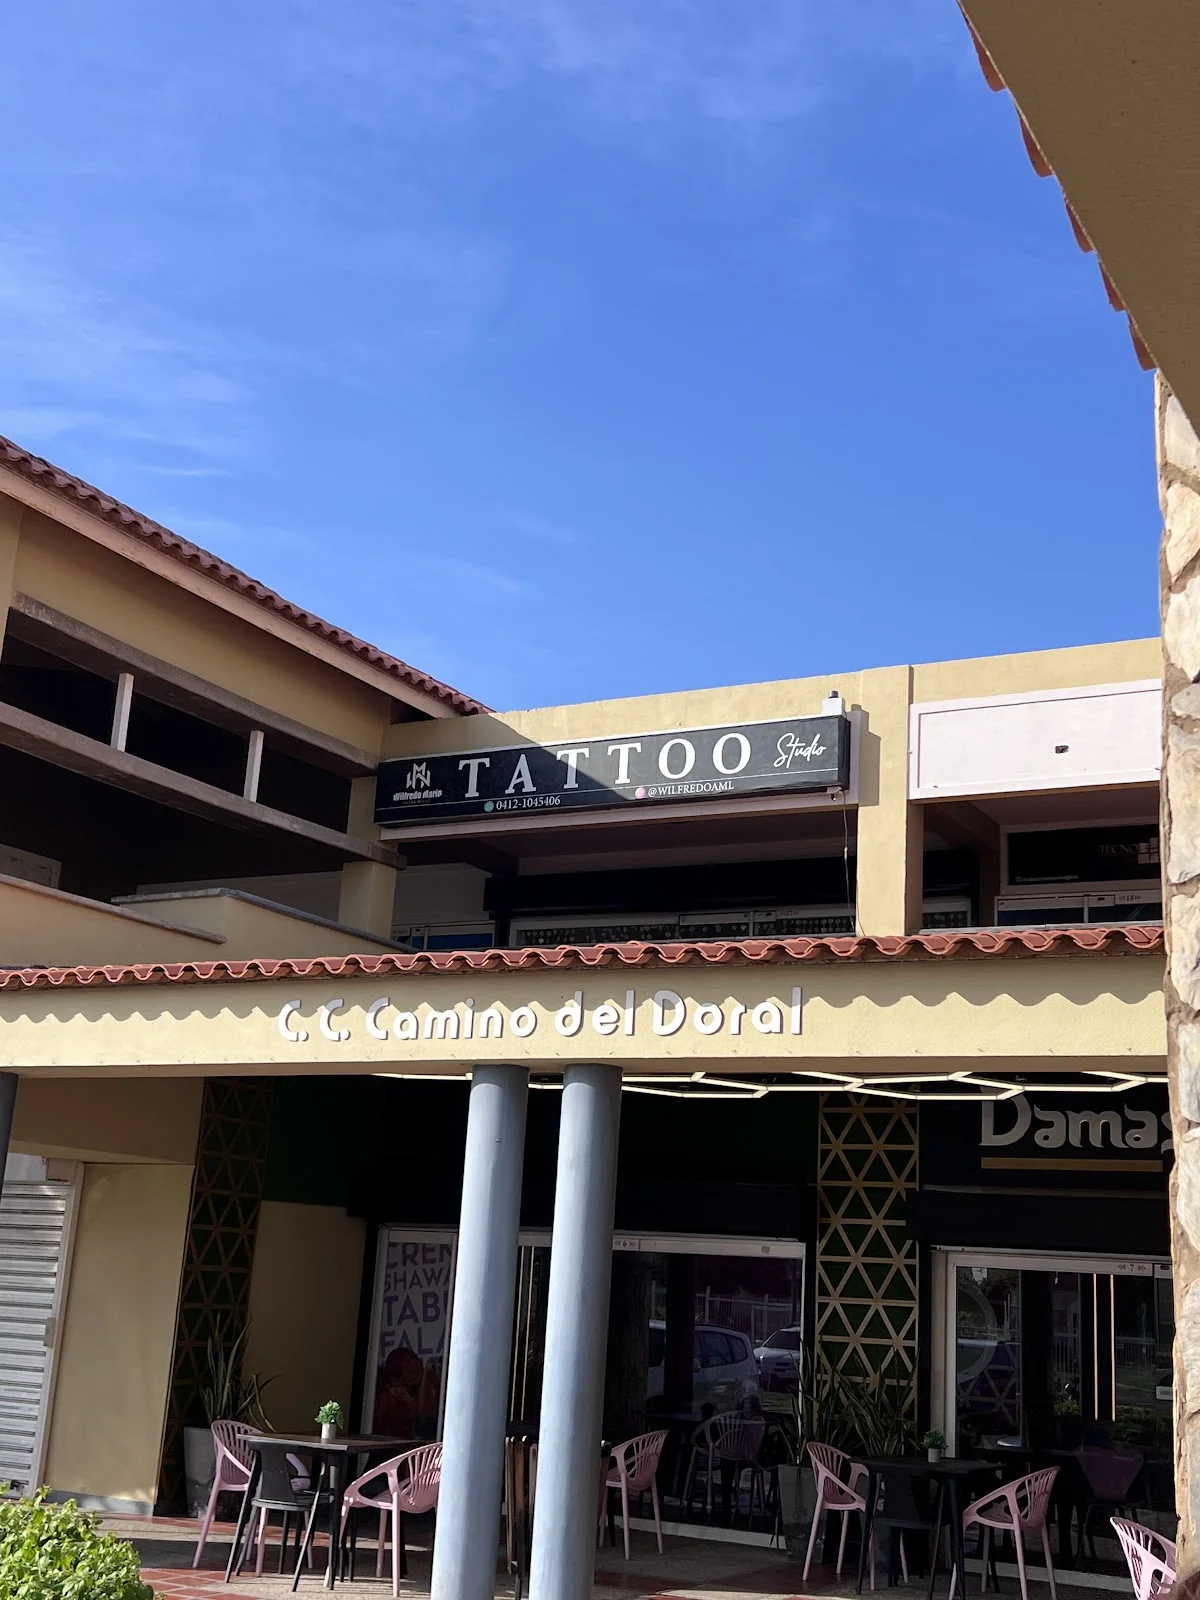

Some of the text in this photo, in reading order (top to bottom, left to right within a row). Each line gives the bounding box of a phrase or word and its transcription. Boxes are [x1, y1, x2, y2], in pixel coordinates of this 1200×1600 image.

[458, 732, 827, 798] TATTOO Studio
[496, 795, 561, 811] 0412-1045406
[648, 781, 735, 798] @WILFREDOAML
[366, 997, 539, 1041] Camino
[554, 990, 636, 1038] del
[651, 986, 803, 1036] Doral
